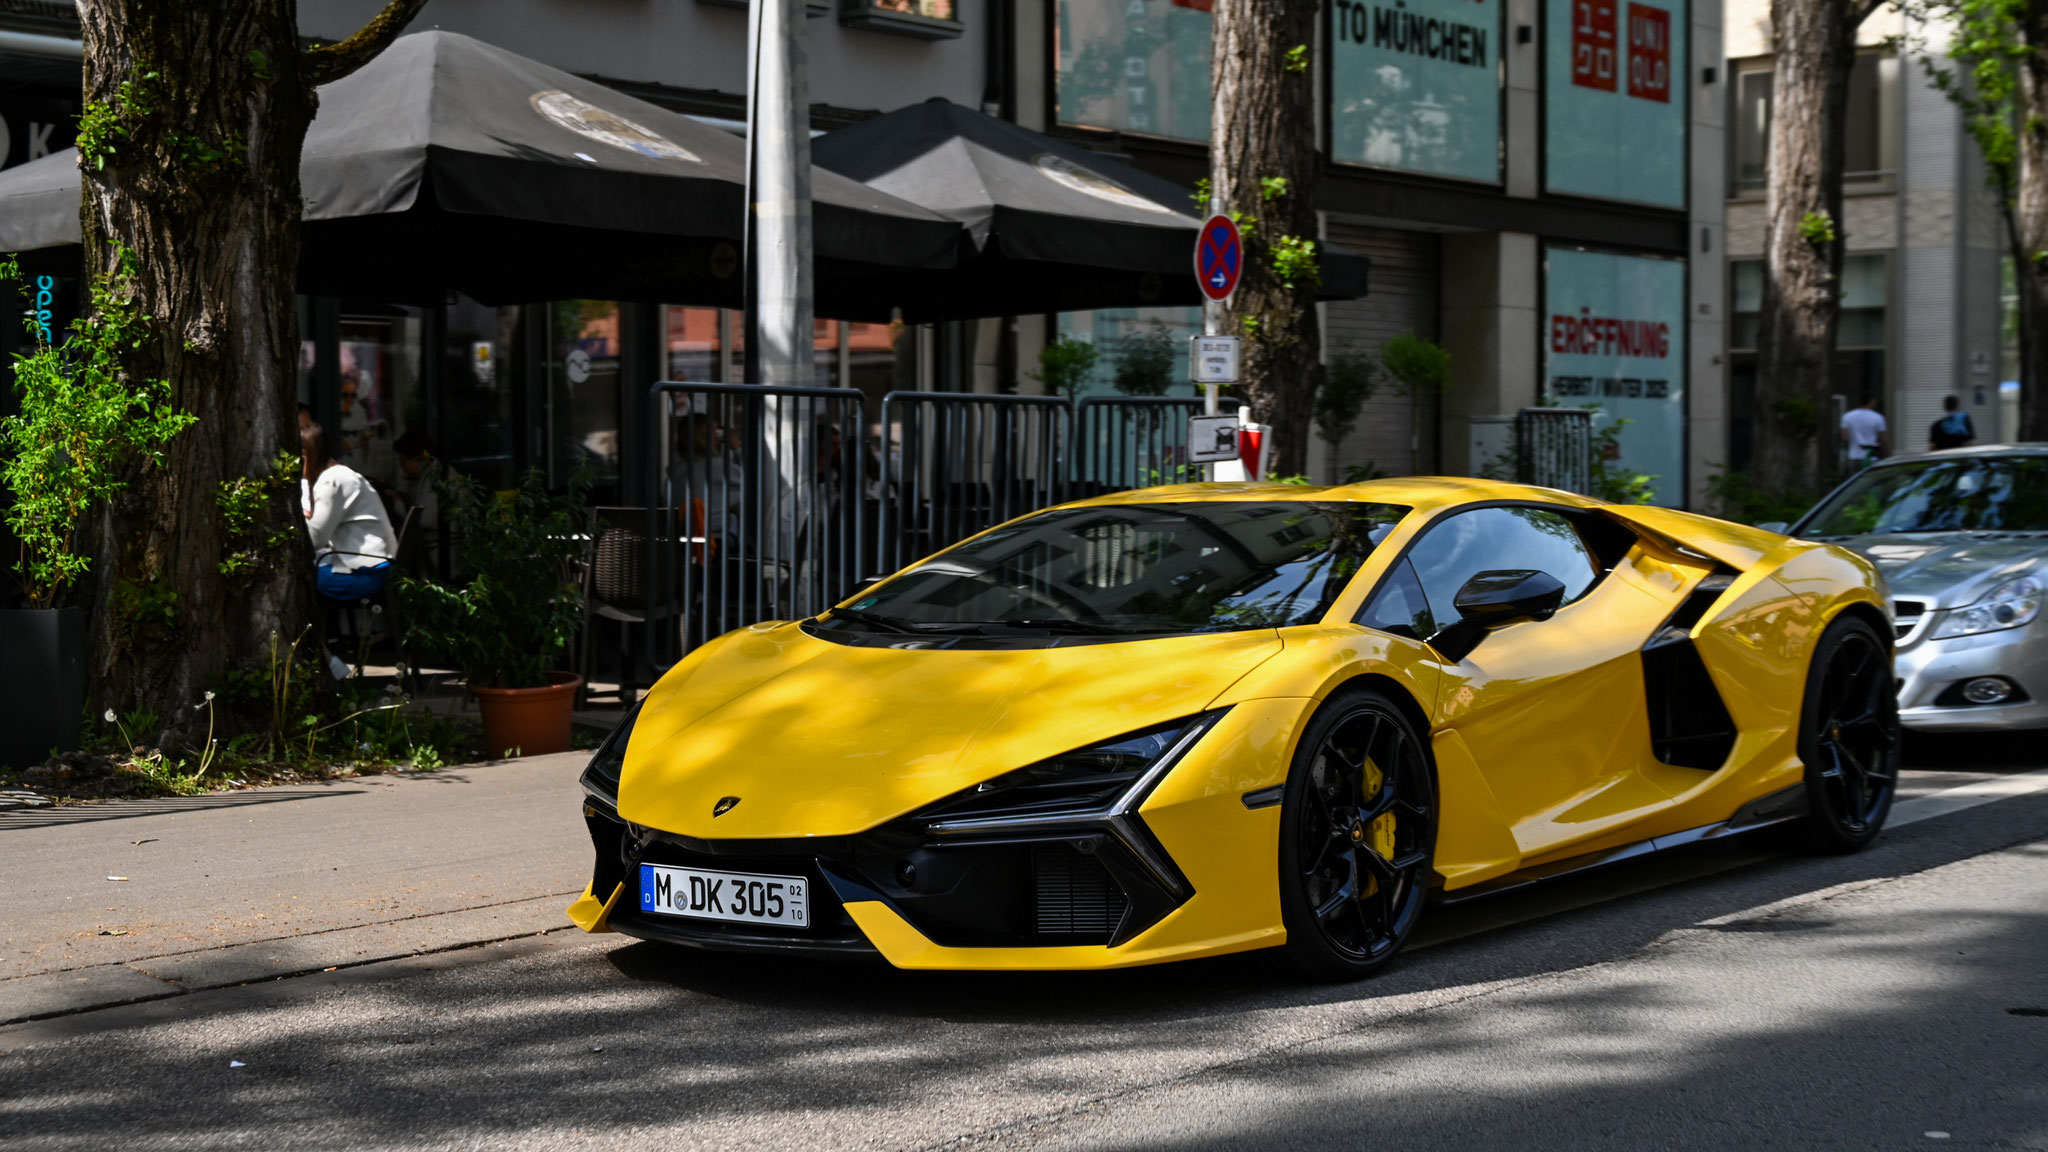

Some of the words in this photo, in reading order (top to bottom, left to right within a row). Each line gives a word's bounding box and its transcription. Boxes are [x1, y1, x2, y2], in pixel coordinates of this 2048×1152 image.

[1336, 0, 1367, 44] TO
[1373, 0, 1486, 68] MÜNCHEN
[1632, 16, 1664, 52] UNI
[1631, 55, 1666, 92] QLO
[36, 275, 54, 344] open
[1552, 306, 1669, 359] ERÖFFNUNG
[645, 893, 650, 903] D
[655, 872, 671, 907] M
[689, 876, 724, 913] DK
[731, 880, 784, 918] 305
[789, 885, 802, 896] 02
[791, 909, 803, 920] 10
